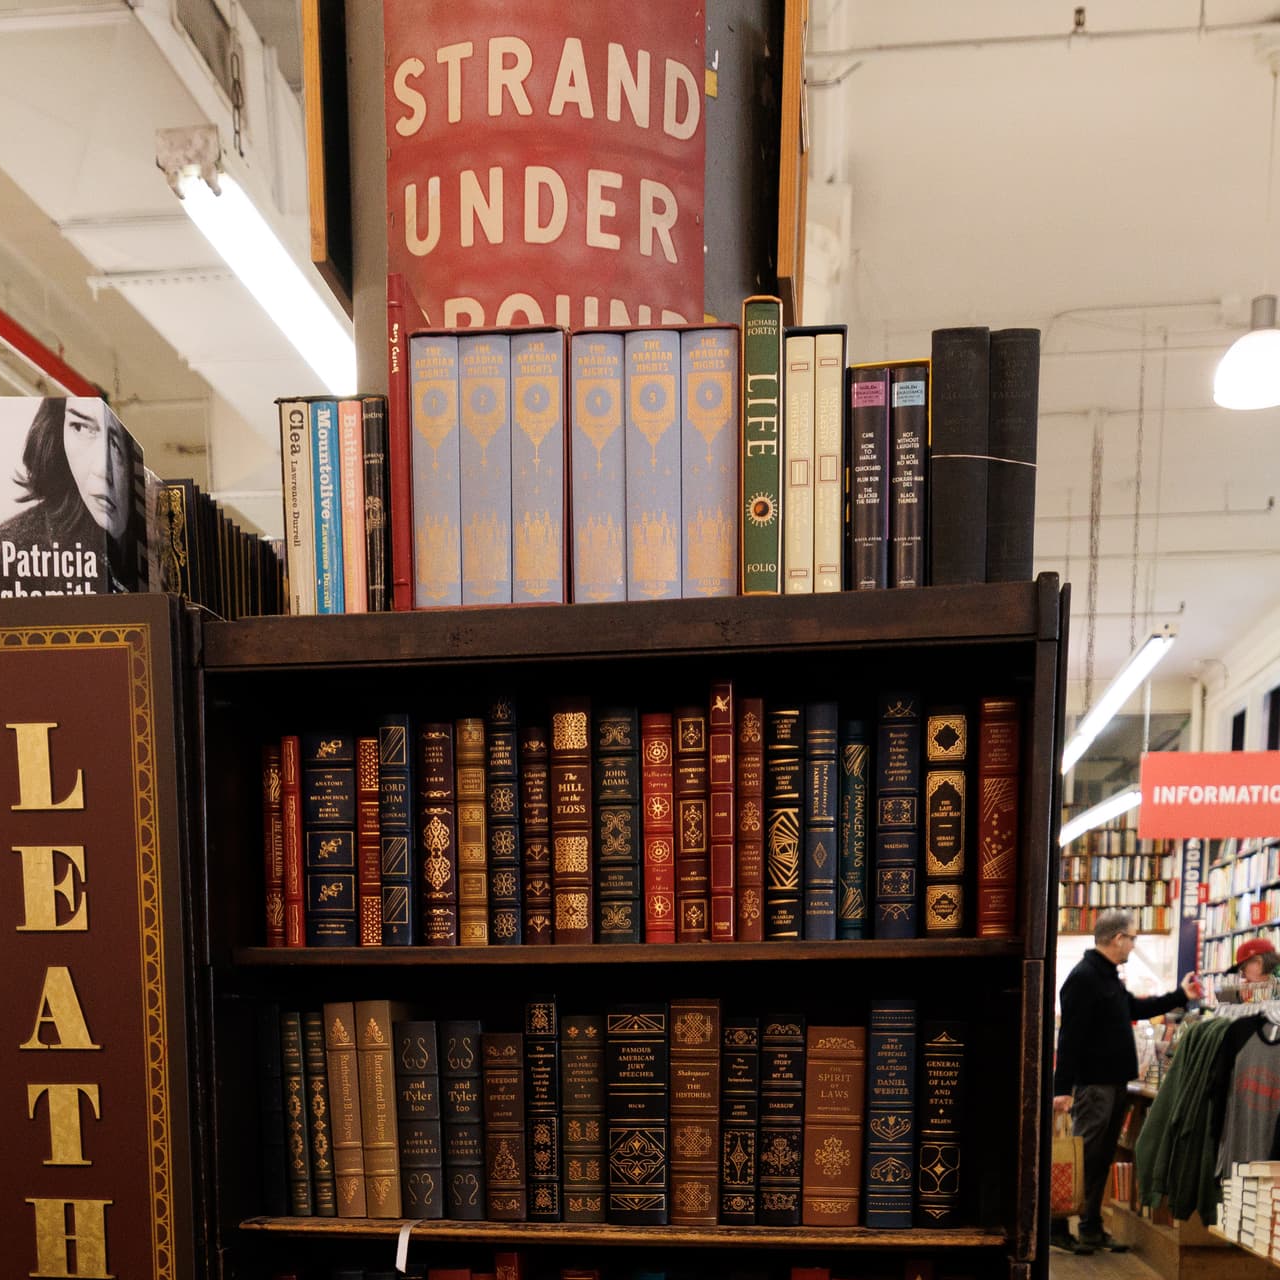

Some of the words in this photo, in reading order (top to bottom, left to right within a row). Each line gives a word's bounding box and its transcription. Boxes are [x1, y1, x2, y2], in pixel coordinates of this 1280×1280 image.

[393, 36, 701, 140] STRAND
[404, 165, 679, 264] UNDER
[747, 319, 778, 327] RICHARD
[748, 327, 777, 336] FORTEY
[748, 373, 777, 457] LIFE
[289, 409, 304, 456] Clea
[317, 408, 334, 519] Mountolive
[291, 460, 299, 508] Lawrence
[293, 511, 301, 547] Durrell
[1, 540, 98, 579] Patricia
[748, 563, 777, 573] FOLIO
[565, 773, 578, 781] The
[602, 778, 629, 786] ADAMS
[381, 784, 405, 792] LORD
[558, 784, 584, 792] MILL
[385, 795, 402, 803] JIM
[557, 805, 586, 814] FLOSS
[854, 783, 864, 838] STRANGER
[854, 841, 864, 867] SUNS
[926, 1060, 960, 1068] GENERAL
[819, 1074, 851, 1082] SPIRIT
[409, 1081, 425, 1089] and
[403, 1091, 432, 1101] Tyler
[448, 1091, 477, 1101] Tyler
